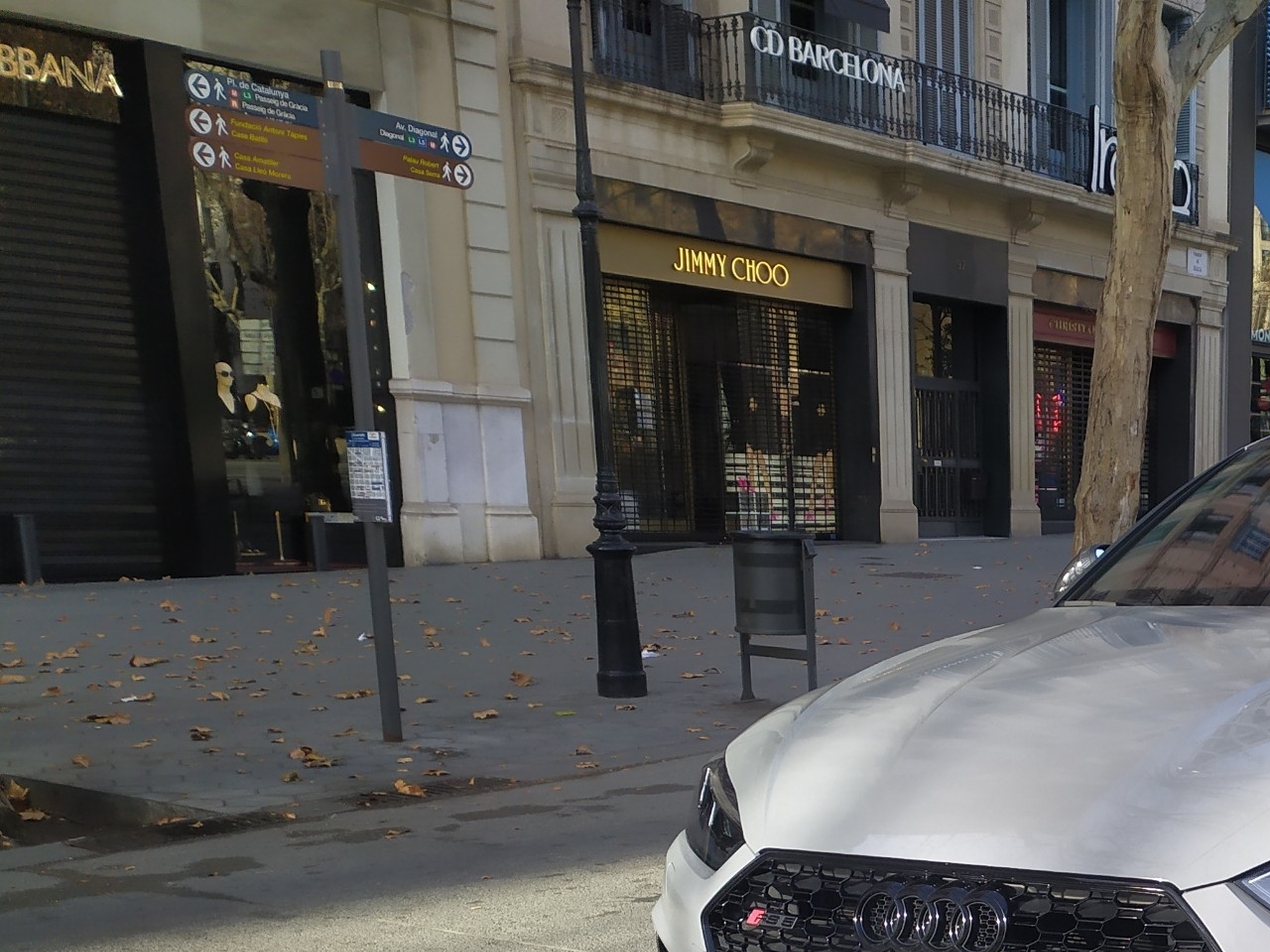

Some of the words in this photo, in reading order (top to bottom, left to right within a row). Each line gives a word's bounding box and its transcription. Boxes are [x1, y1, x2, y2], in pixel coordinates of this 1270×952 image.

[750, 25, 784, 57] CD
[788, 36, 906, 93] BARCELONA
[226, 77, 238, 88] Pl.
[240, 80, 249, 90] de
[251, 83, 290, 99] Catalunya
[255, 93, 280, 108] Passeig
[279, 99, 288, 108] de
[241, 101, 267, 115] Passeig
[267, 106, 276, 115] de
[231, 130, 248, 140] Casa
[379, 128, 405, 141] Diagonal
[395, 121, 407, 131] Av.
[408, 124, 438, 138] Diagonal
[234, 152, 251, 162] Casa
[235, 162, 252, 173] Casa
[410, 166, 425, 176] Casa
[673, 247, 727, 278] JIMMY
[731, 257, 789, 287] CHOO
